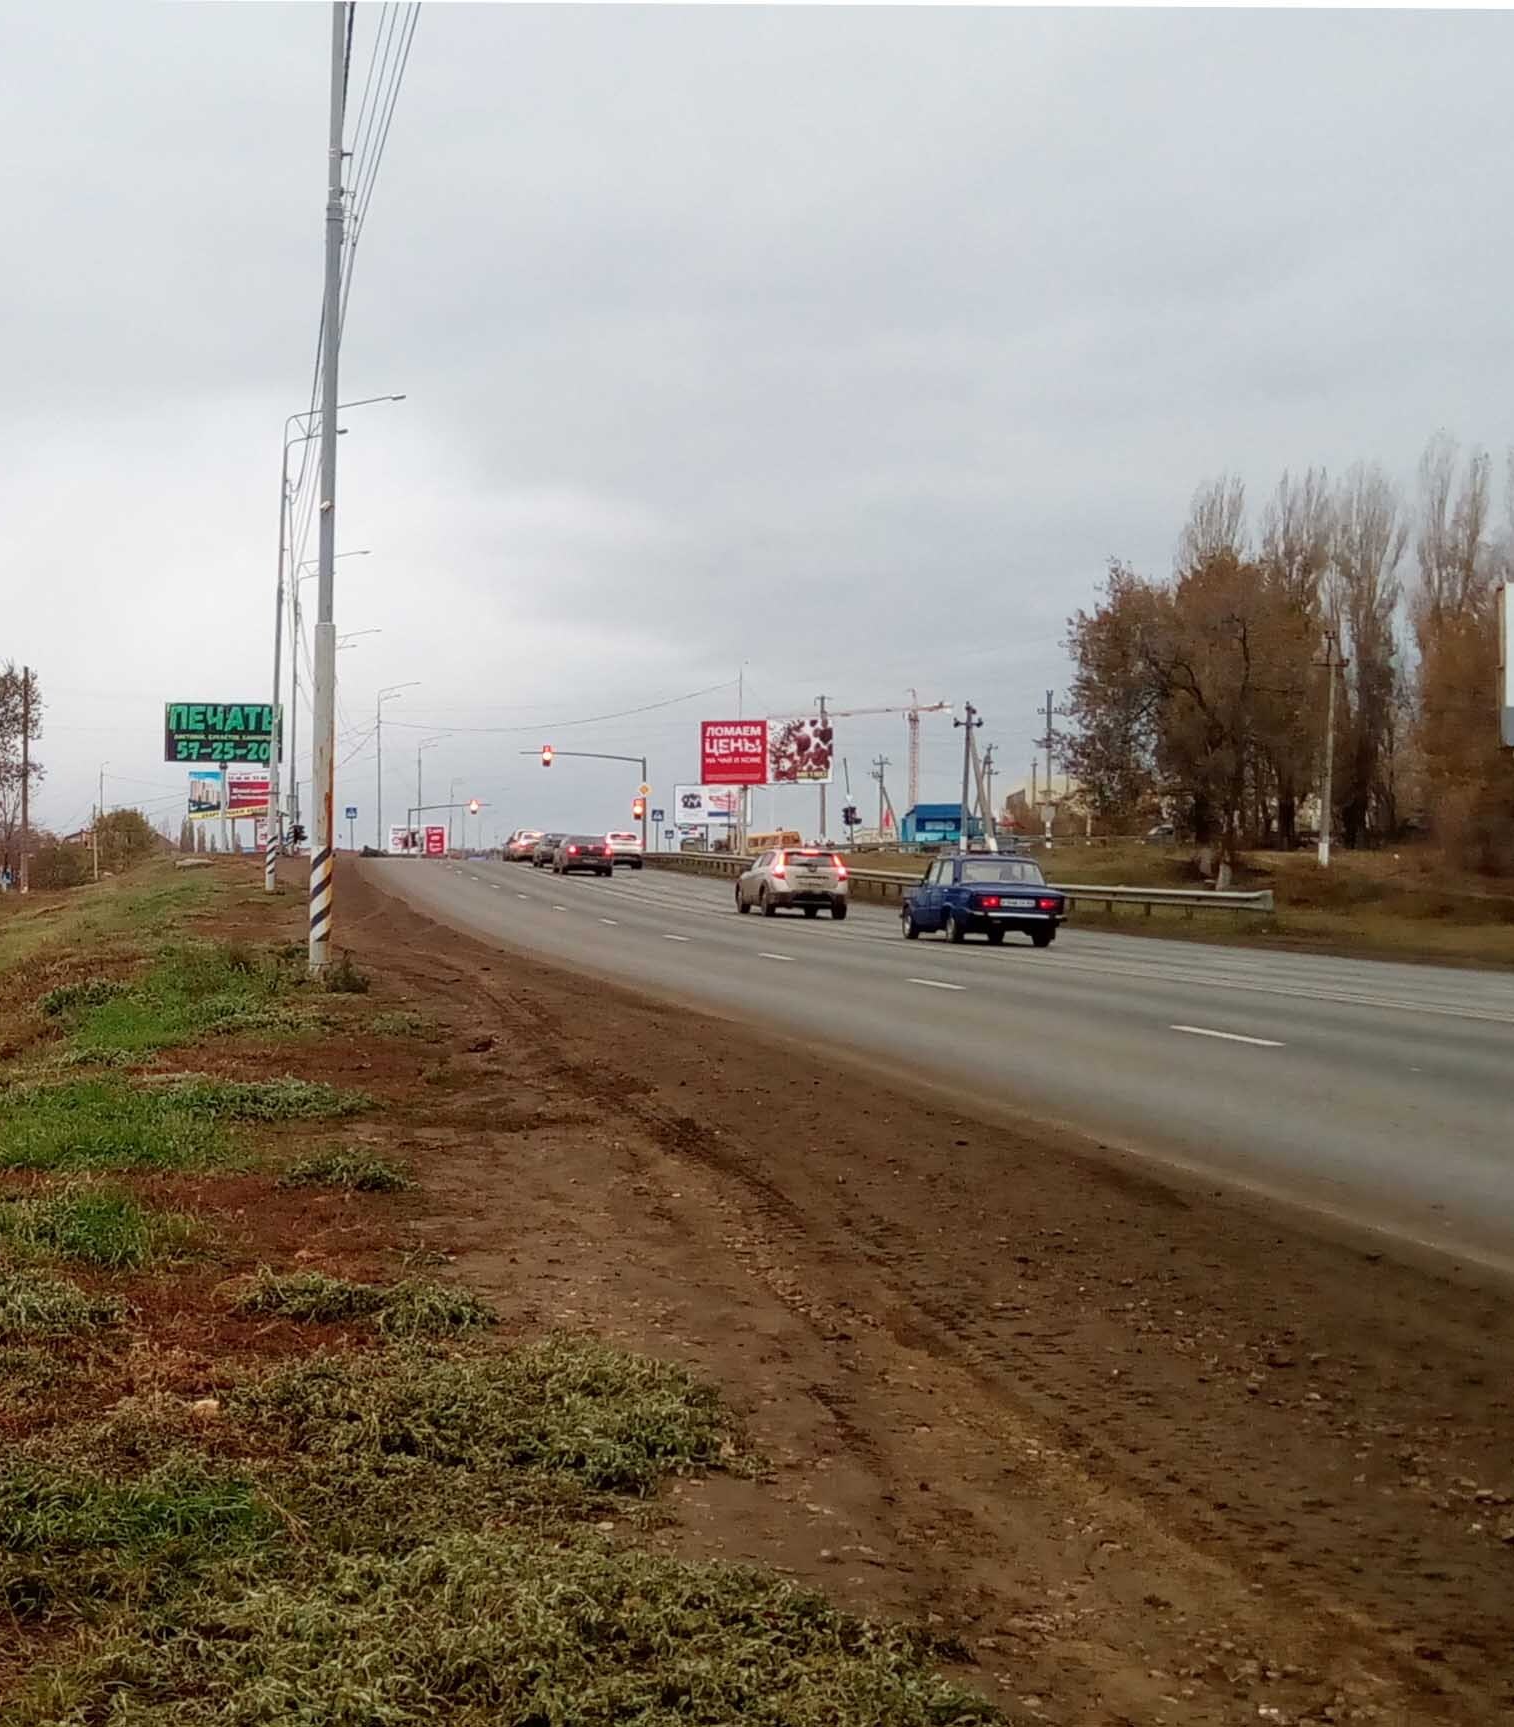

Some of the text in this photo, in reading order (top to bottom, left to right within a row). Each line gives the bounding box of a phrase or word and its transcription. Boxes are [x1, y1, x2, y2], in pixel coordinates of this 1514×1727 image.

[169, 704, 273, 732] ПЕЧАТЬ
[706, 726, 762, 736] ЛОМАЕМ
[176, 741, 271, 761] 57-25-20
[705, 738, 763, 756] ЦЕНЫ
